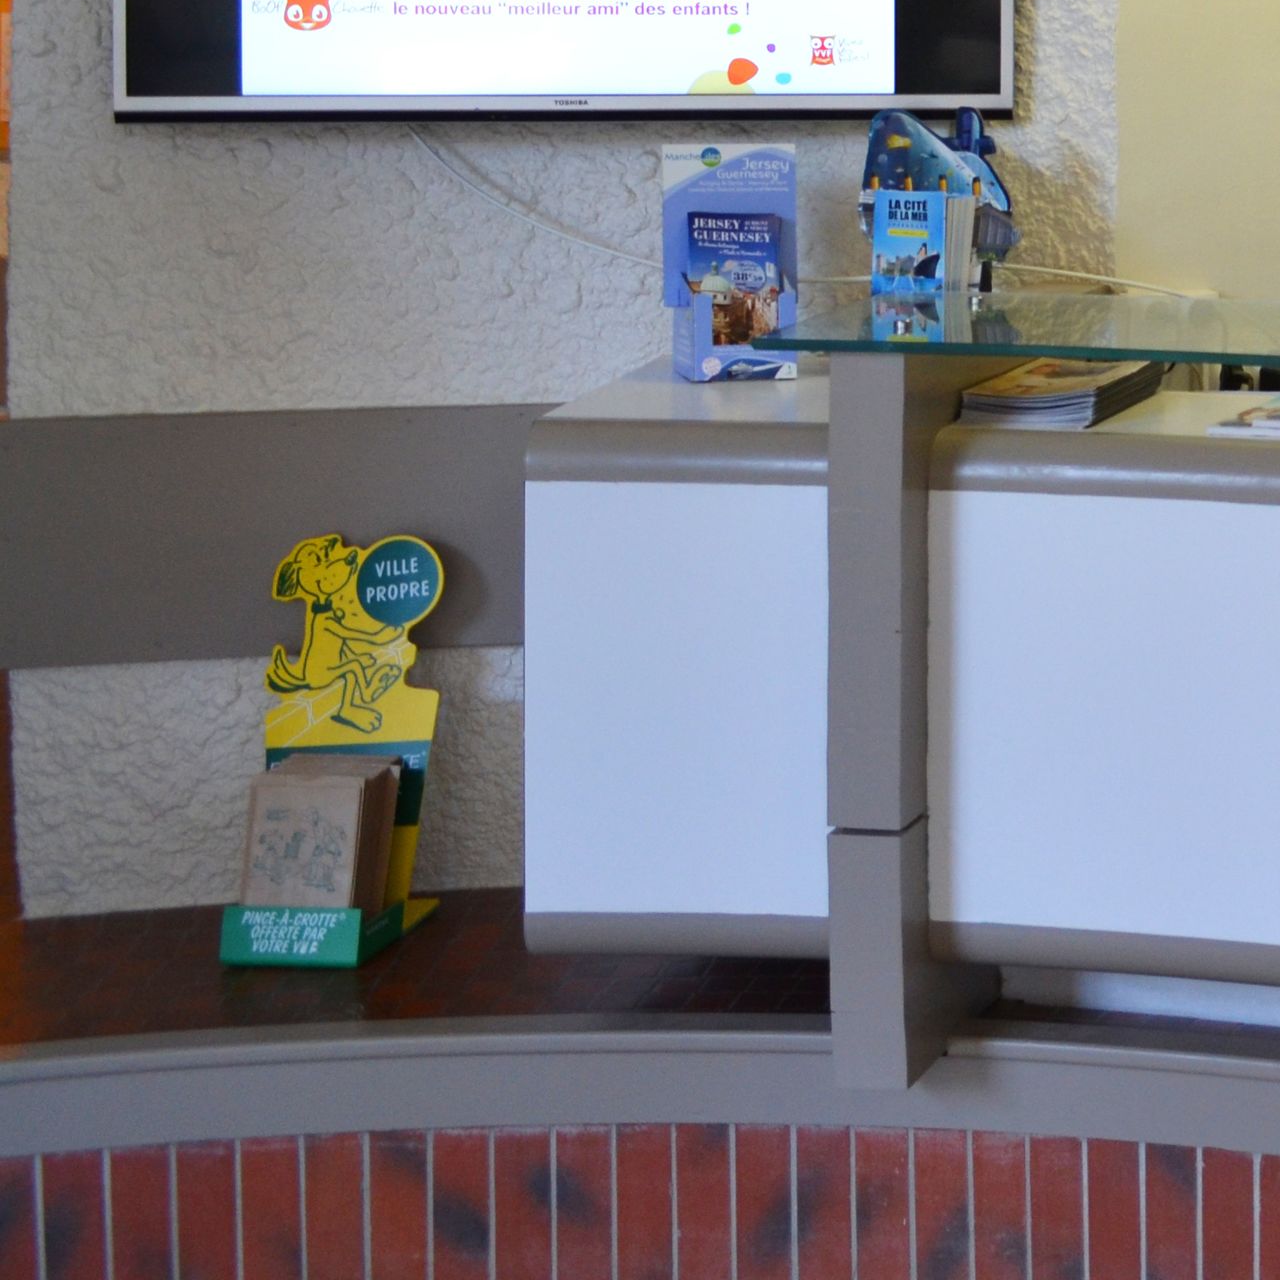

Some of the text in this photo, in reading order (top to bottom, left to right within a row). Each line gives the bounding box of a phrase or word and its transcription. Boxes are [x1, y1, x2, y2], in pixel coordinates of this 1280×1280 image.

[393, 1, 409, 16] le
[415, 4, 492, 16] nouveau
[634, 1, 666, 16] des
[672, 1, 739, 16] enfants
[742, 158, 790, 173] Jersey
[717, 169, 779, 180] Guernesey
[889, 200, 900, 210] LA
[692, 217, 740, 229] JERSEY
[693, 230, 771, 243] GUERNESEY
[375, 557, 418, 578] VILLE
[366, 580, 430, 603] PROPRE
[251, 926, 327, 940] OFFERTE PAR
[251, 940, 290, 952] VOTRE
